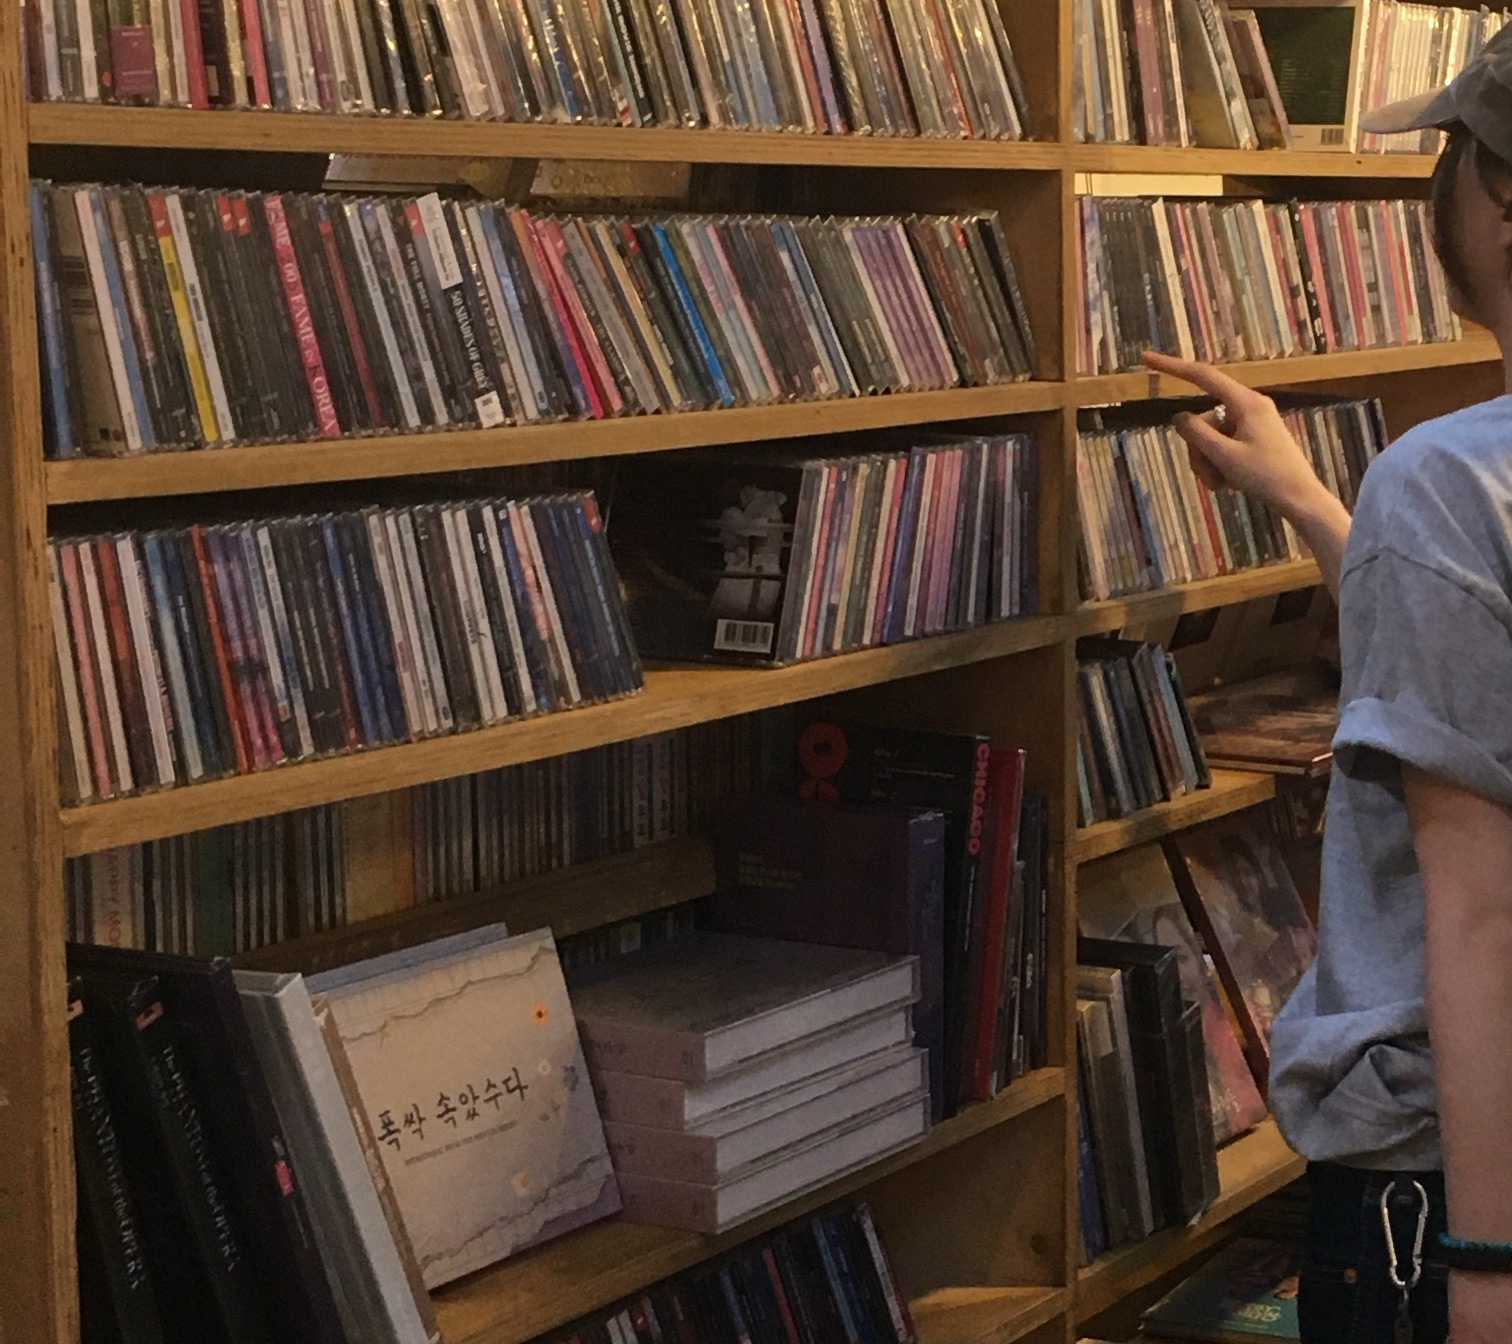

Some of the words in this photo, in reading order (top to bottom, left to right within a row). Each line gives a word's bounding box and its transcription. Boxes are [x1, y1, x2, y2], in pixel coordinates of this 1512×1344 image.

[288, 292, 318, 347] FAME
[449, 290, 465, 307] 50
[454, 305, 477, 348] SHADES
[466, 346, 481, 361] OF
[967, 742, 992, 855] CHICAGO
[378, 1103, 427, 1152] 폭싹
[436, 1066, 529, 1129] 속았수다
